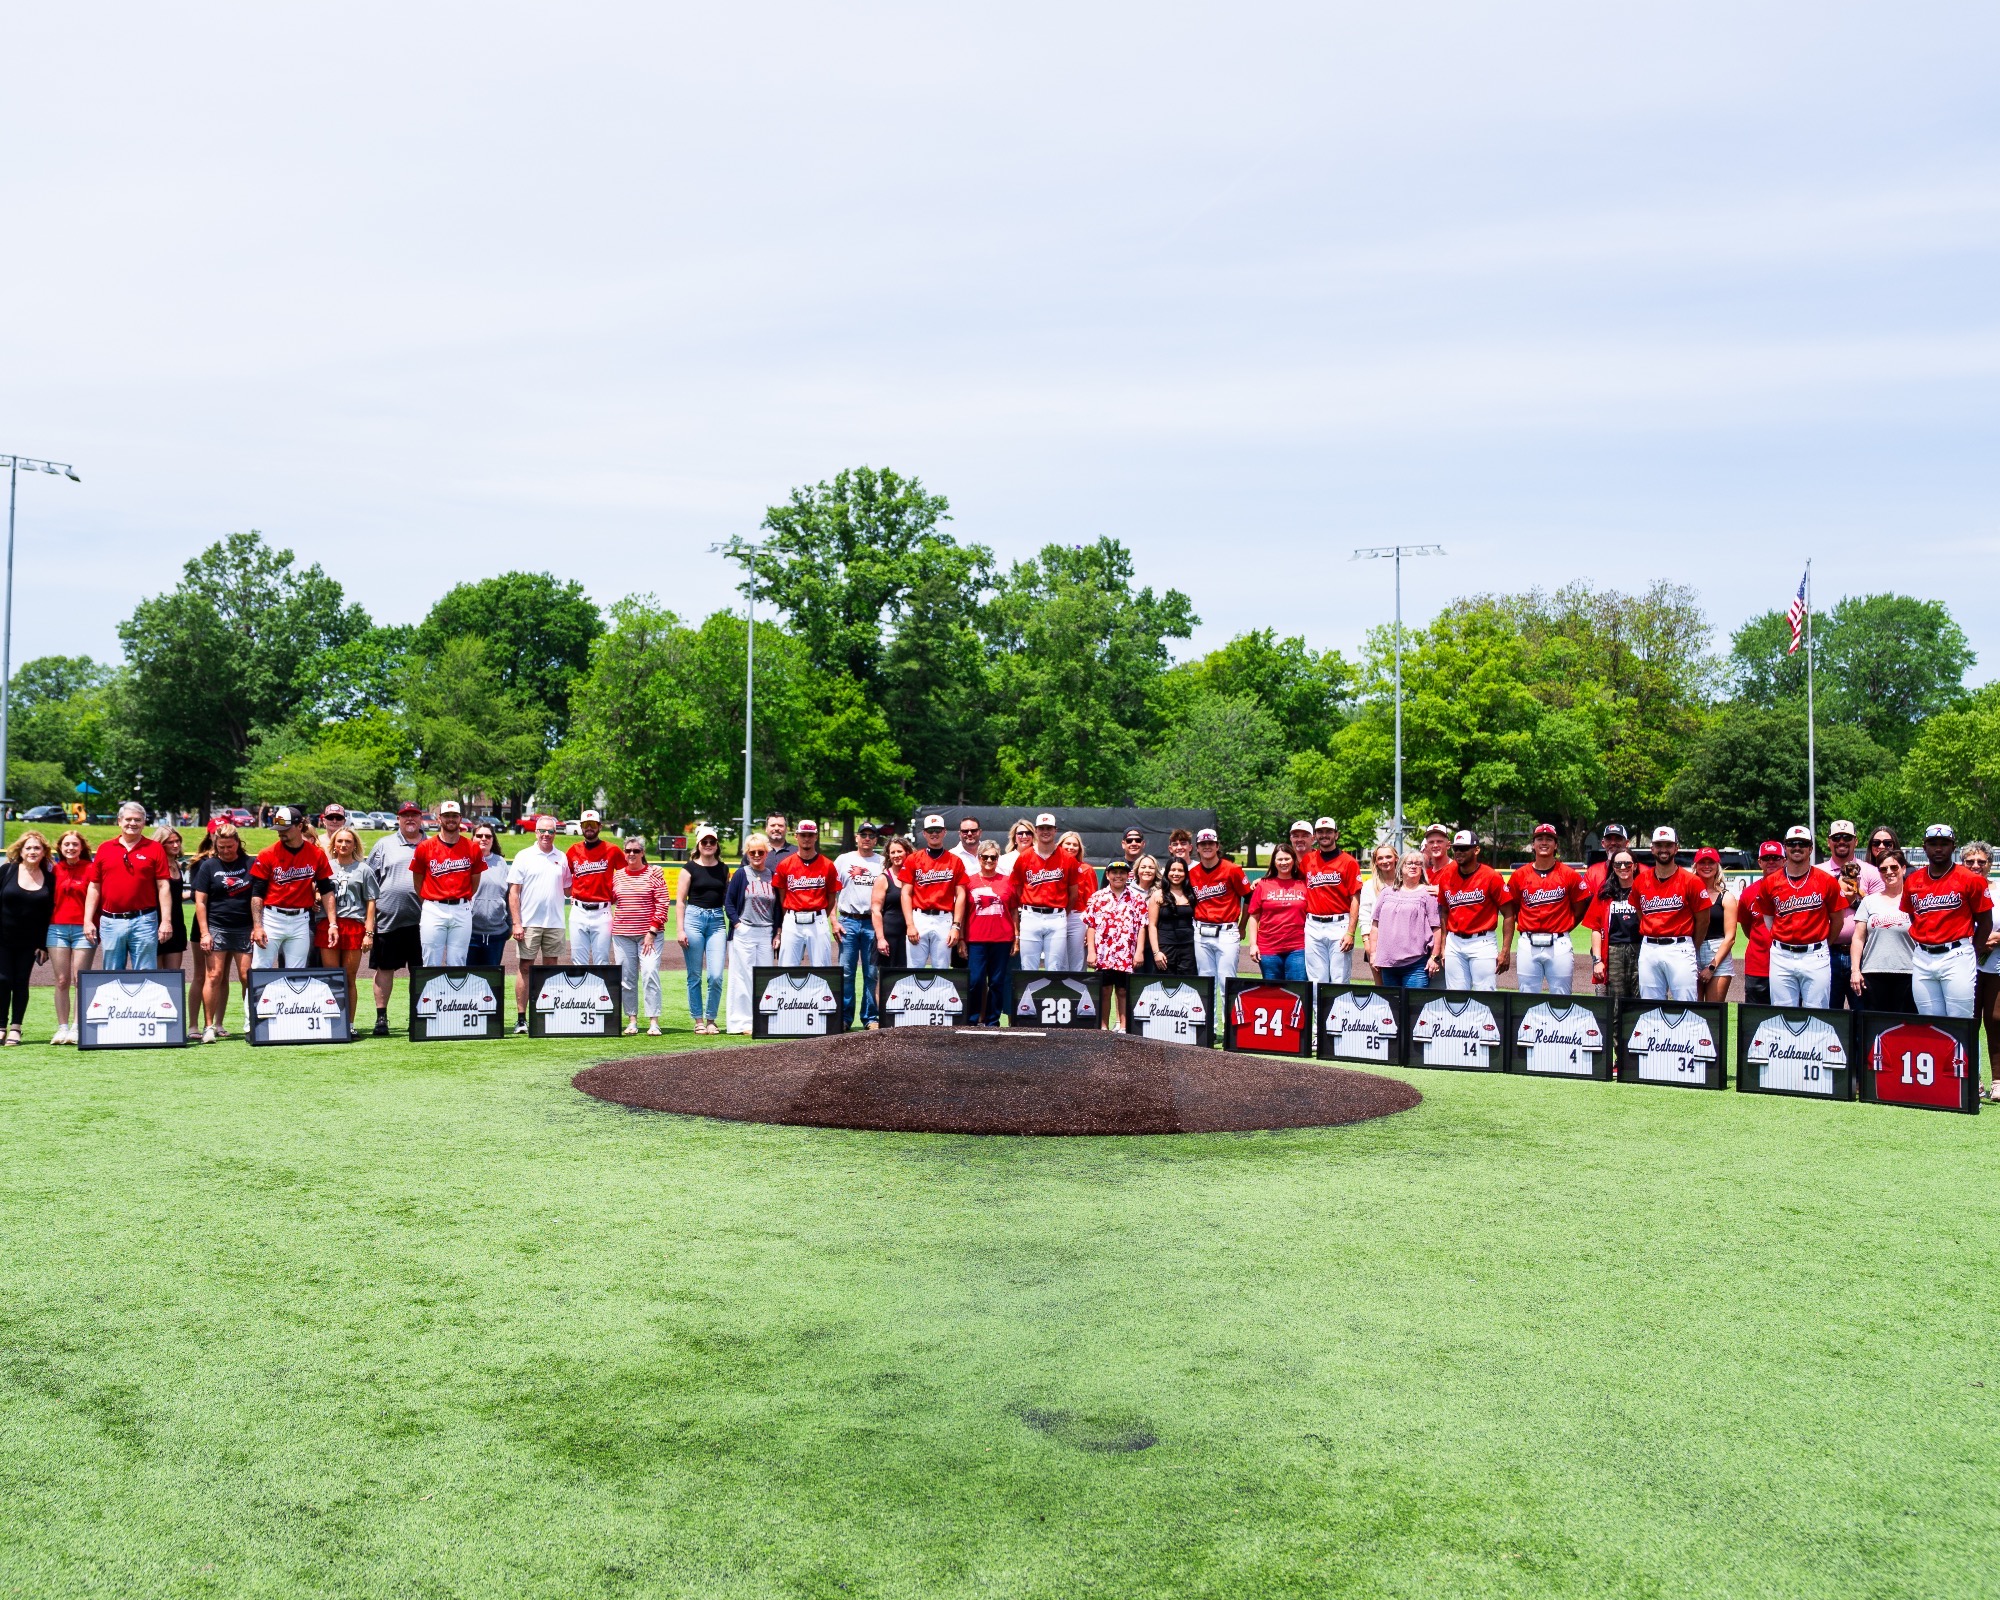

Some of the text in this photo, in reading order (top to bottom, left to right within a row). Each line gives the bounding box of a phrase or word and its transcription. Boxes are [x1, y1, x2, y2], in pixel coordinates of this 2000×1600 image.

[855, 874, 877, 884] SEM
[1640, 895, 1683, 910] Redhawks
[1774, 893, 1822, 910] Redhawks
[1911, 892, 1962, 908] Redhawks
[277, 1002, 322, 1015] Redhawks
[436, 999, 478, 1012] Redhawks
[554, 997, 596, 1010] Redhawks
[777, 998, 818, 1010] Redhawks
[904, 998, 944, 1011] Redhawks
[108, 1006, 156, 1019] Redhawks
[1041, 998, 1072, 1024] 28
[1149, 1004, 1189, 1019] Redhawks
[308, 1017, 320, 1030] 31
[464, 1015, 478, 1027] 20
[580, 1012, 595, 1025] 35
[807, 1013, 813, 1025] 6
[930, 1013, 943, 1025] 23
[1254, 1008, 1283, 1037] 24
[139, 1023, 155, 1036] 39
[1175, 1021, 1186, 1034] 12
[1432, 1024, 1479, 1039] Redhawks
[1366, 1036, 1380, 1049] 26
[1535, 1029, 1582, 1046] Redhawks
[1463, 1042, 1477, 1056] 14
[1648, 1037, 1694, 1053] Redhawks
[1570, 1049, 1577, 1063] 4
[1769, 1043, 1822, 1062] Redhawks
[1678, 1058, 1694, 1072] 34
[1901, 1051, 1934, 1085] 19
[1804, 1065, 1820, 1081] 10
